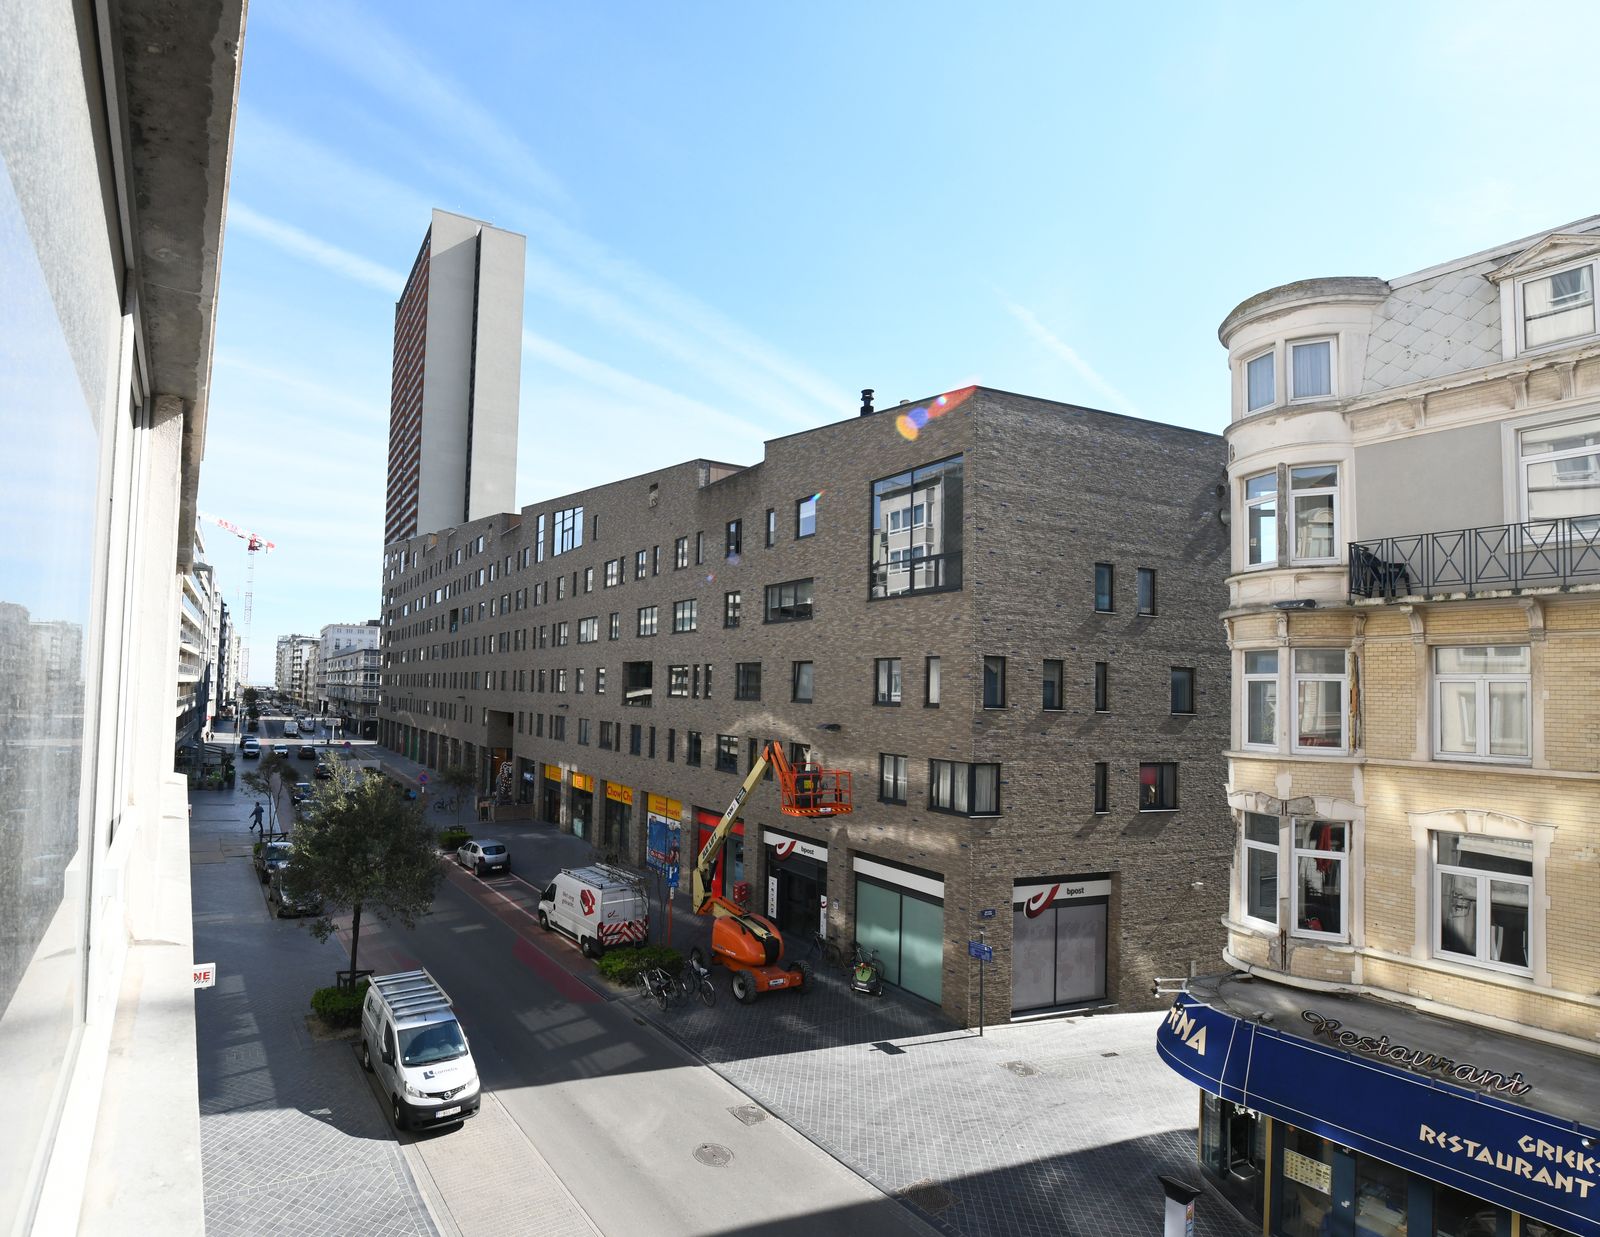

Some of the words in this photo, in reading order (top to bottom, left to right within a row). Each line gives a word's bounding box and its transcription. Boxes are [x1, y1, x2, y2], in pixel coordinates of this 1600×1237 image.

[801, 846, 815, 855] bpost
[1066, 887, 1085, 896] bpost
[1301, 1009, 1532, 1097] Restaurant
[1419, 1124, 1597, 1198] RESTAURANT
